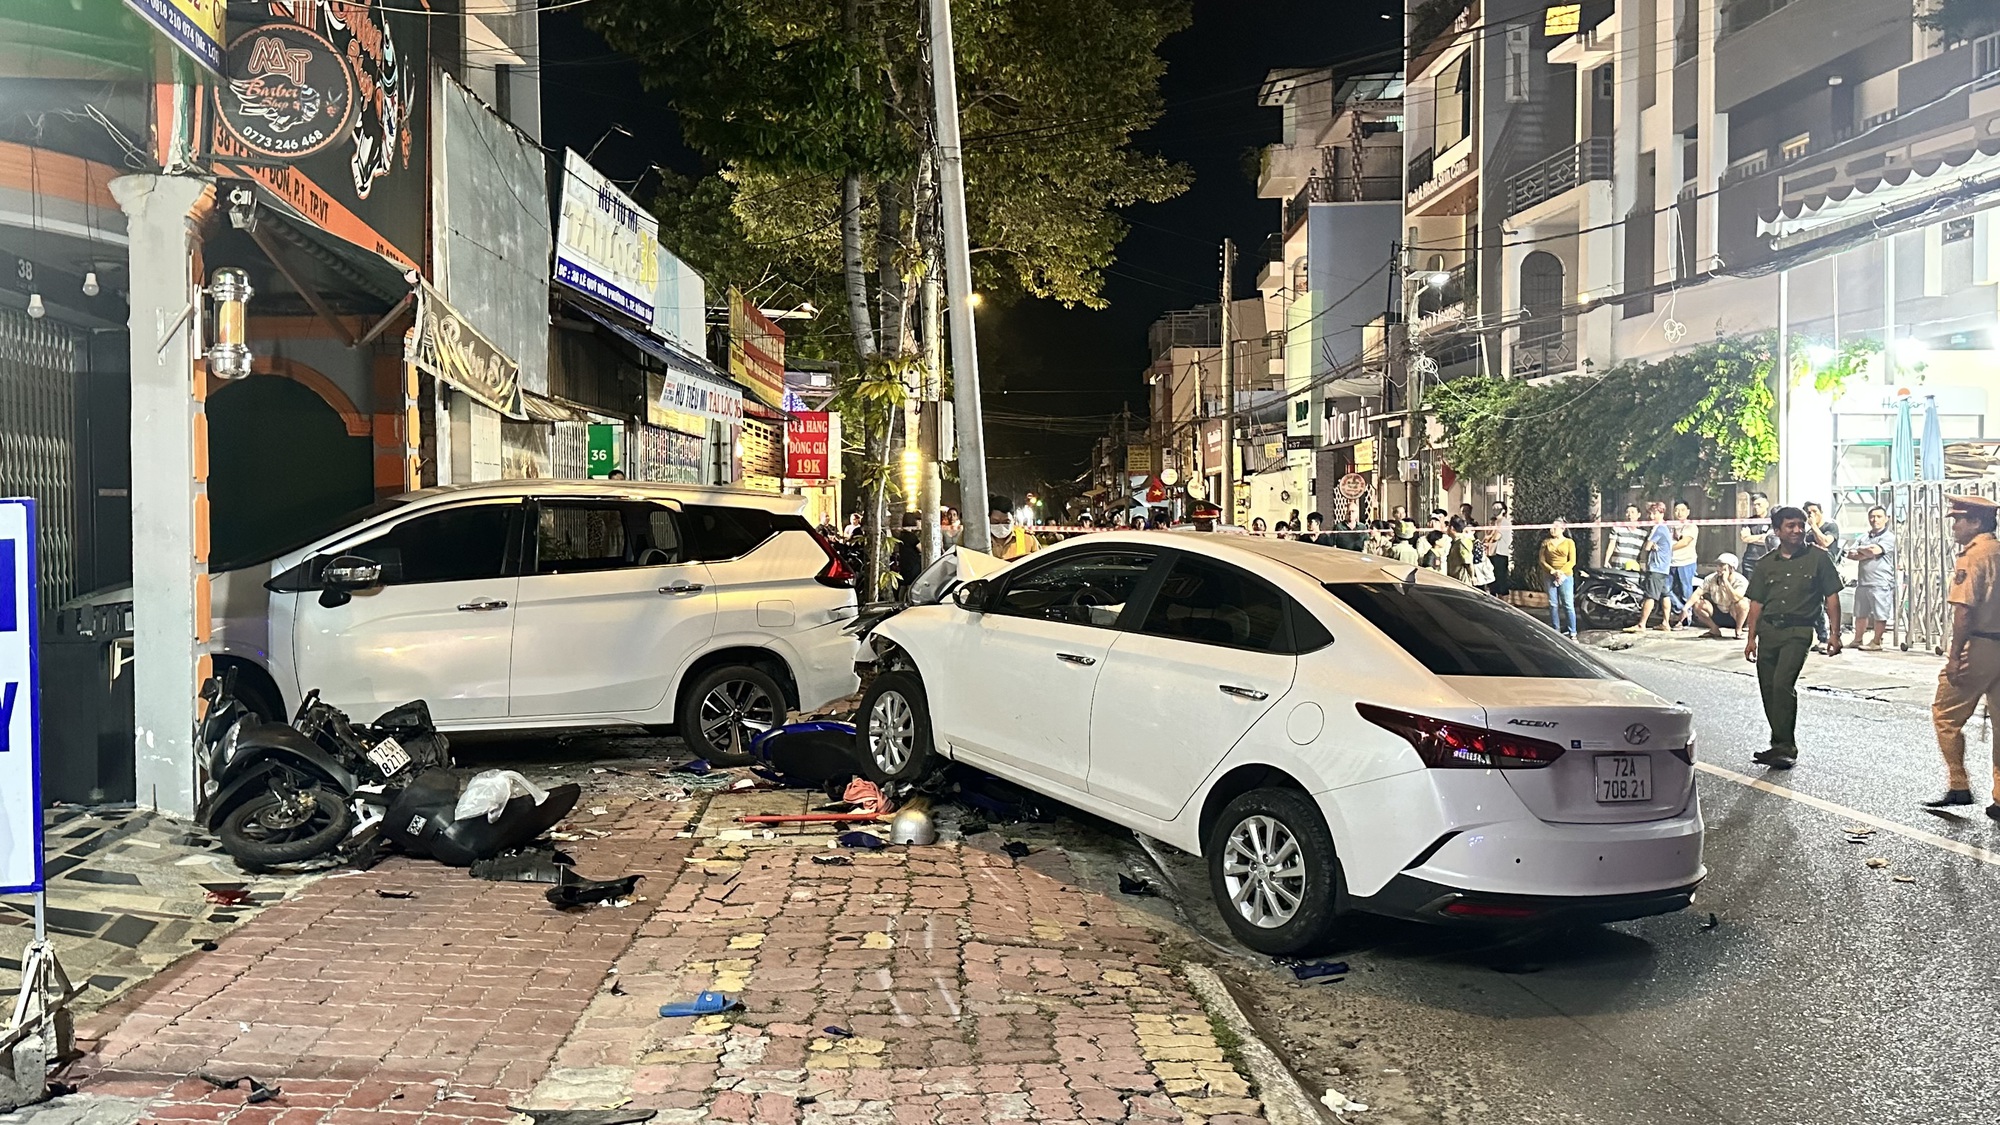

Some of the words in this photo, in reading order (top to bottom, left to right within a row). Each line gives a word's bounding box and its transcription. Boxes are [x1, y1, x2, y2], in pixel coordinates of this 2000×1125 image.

[169, 10, 181, 31] 210
[182, 20, 195, 42] 074
[245, 78, 298, 99] Barber
[258, 96, 289, 112] Shop
[242, 126, 272, 148] 0773
[275, 139, 298, 150] 246
[301, 129, 324, 146] 468
[309, 190, 329, 224] TP.VT
[18, 258, 33, 281] 38
[637, 229, 659, 294] 36
[708, 387, 720, 413] TÀI
[735, 398, 742, 419] 36
[806, 416, 828, 434] HÀNG
[1348, 396, 1372, 441] HẢI
[591, 449, 607, 461] 36
[789, 437, 811, 455] ĐỒNG
[813, 437, 828, 455] GIÁ
[796, 459, 821, 474] 19K
[1507, 718, 1559, 728] ACCENT
[1613, 758, 1636, 777] 72A
[1603, 780, 1645, 799] 708.21
